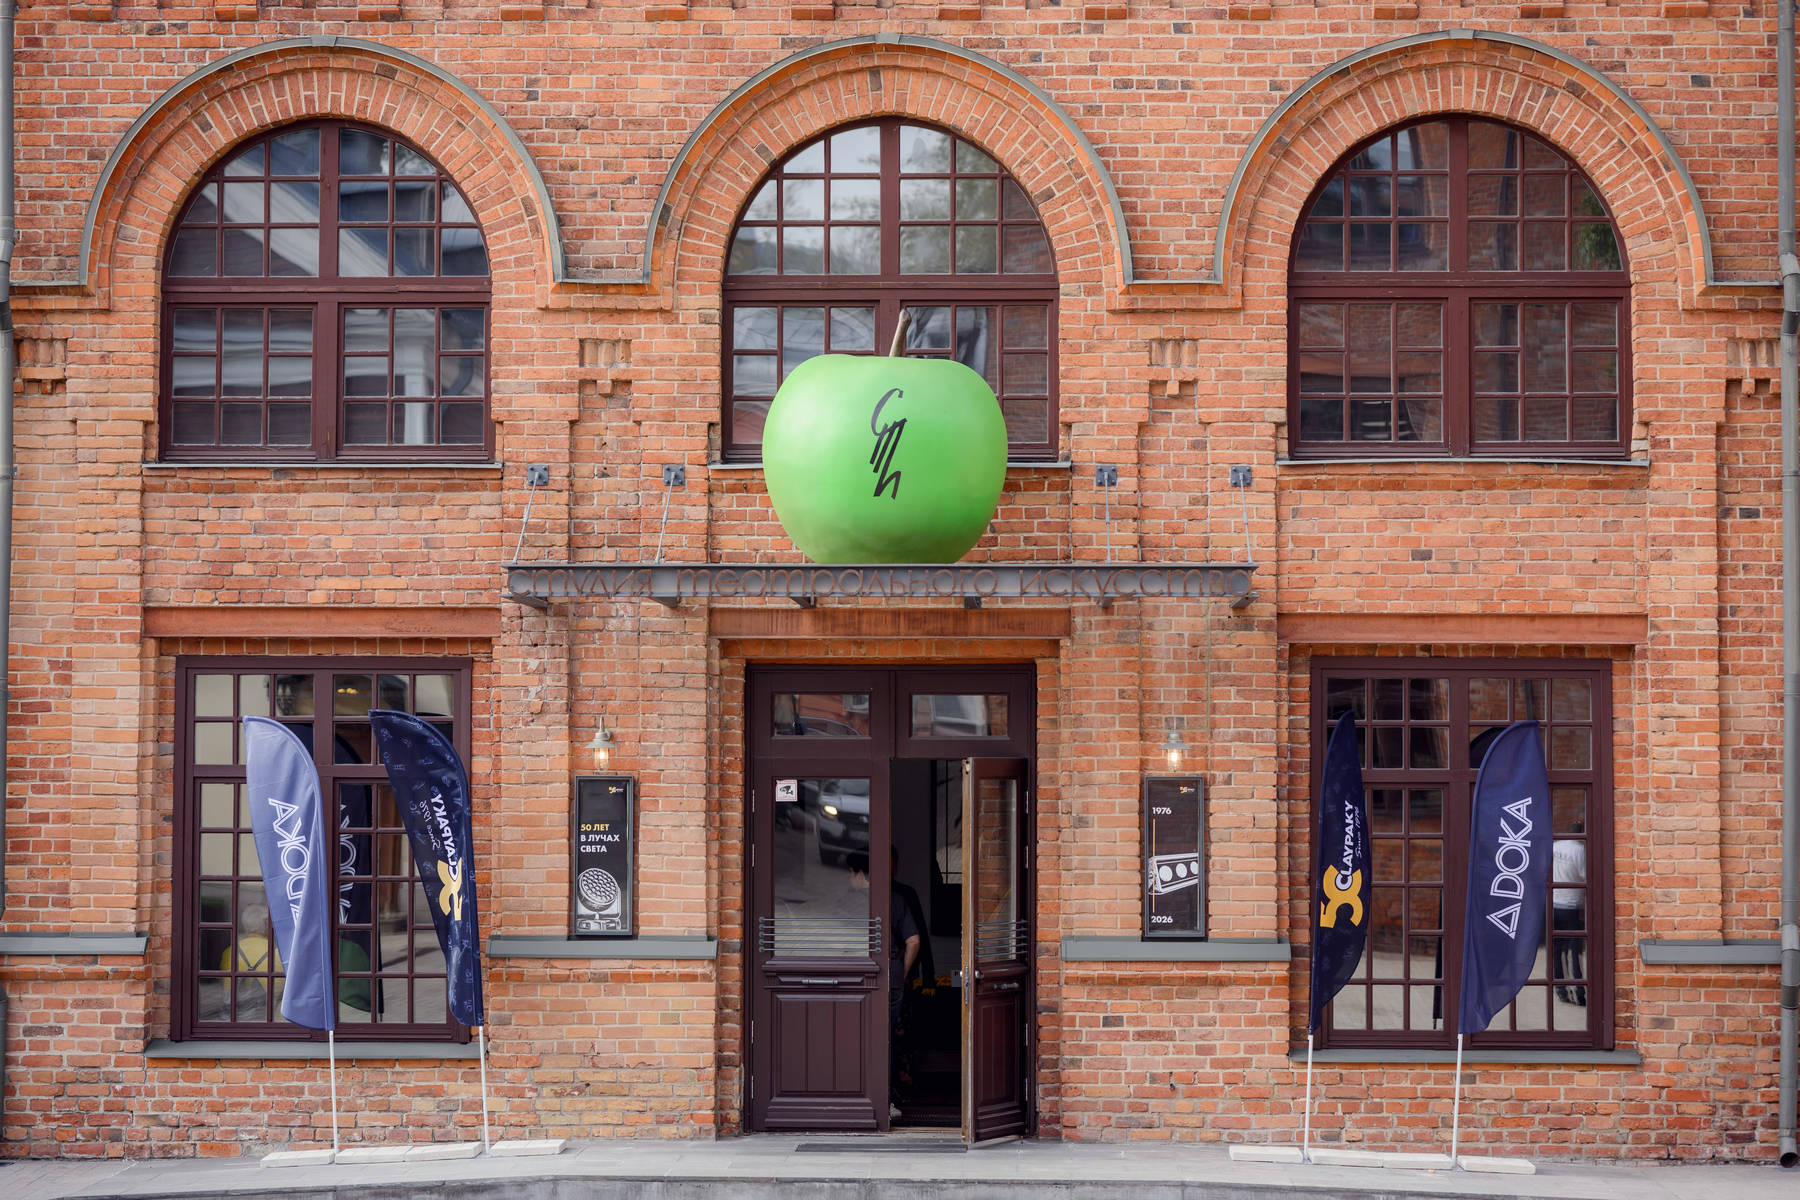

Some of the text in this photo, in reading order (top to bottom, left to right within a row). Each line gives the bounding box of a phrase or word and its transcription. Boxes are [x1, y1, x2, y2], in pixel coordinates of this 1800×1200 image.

[1152, 807, 1172, 815] 1976
[581, 823, 610, 831] 50 ЛЕТ
[580, 834, 620, 842] В ЛУЧАХ
[580, 845, 608, 853] СВЕТА
[1334, 800, 1353, 891] CLAYPAKY
[1151, 915, 1173, 924] 2026
